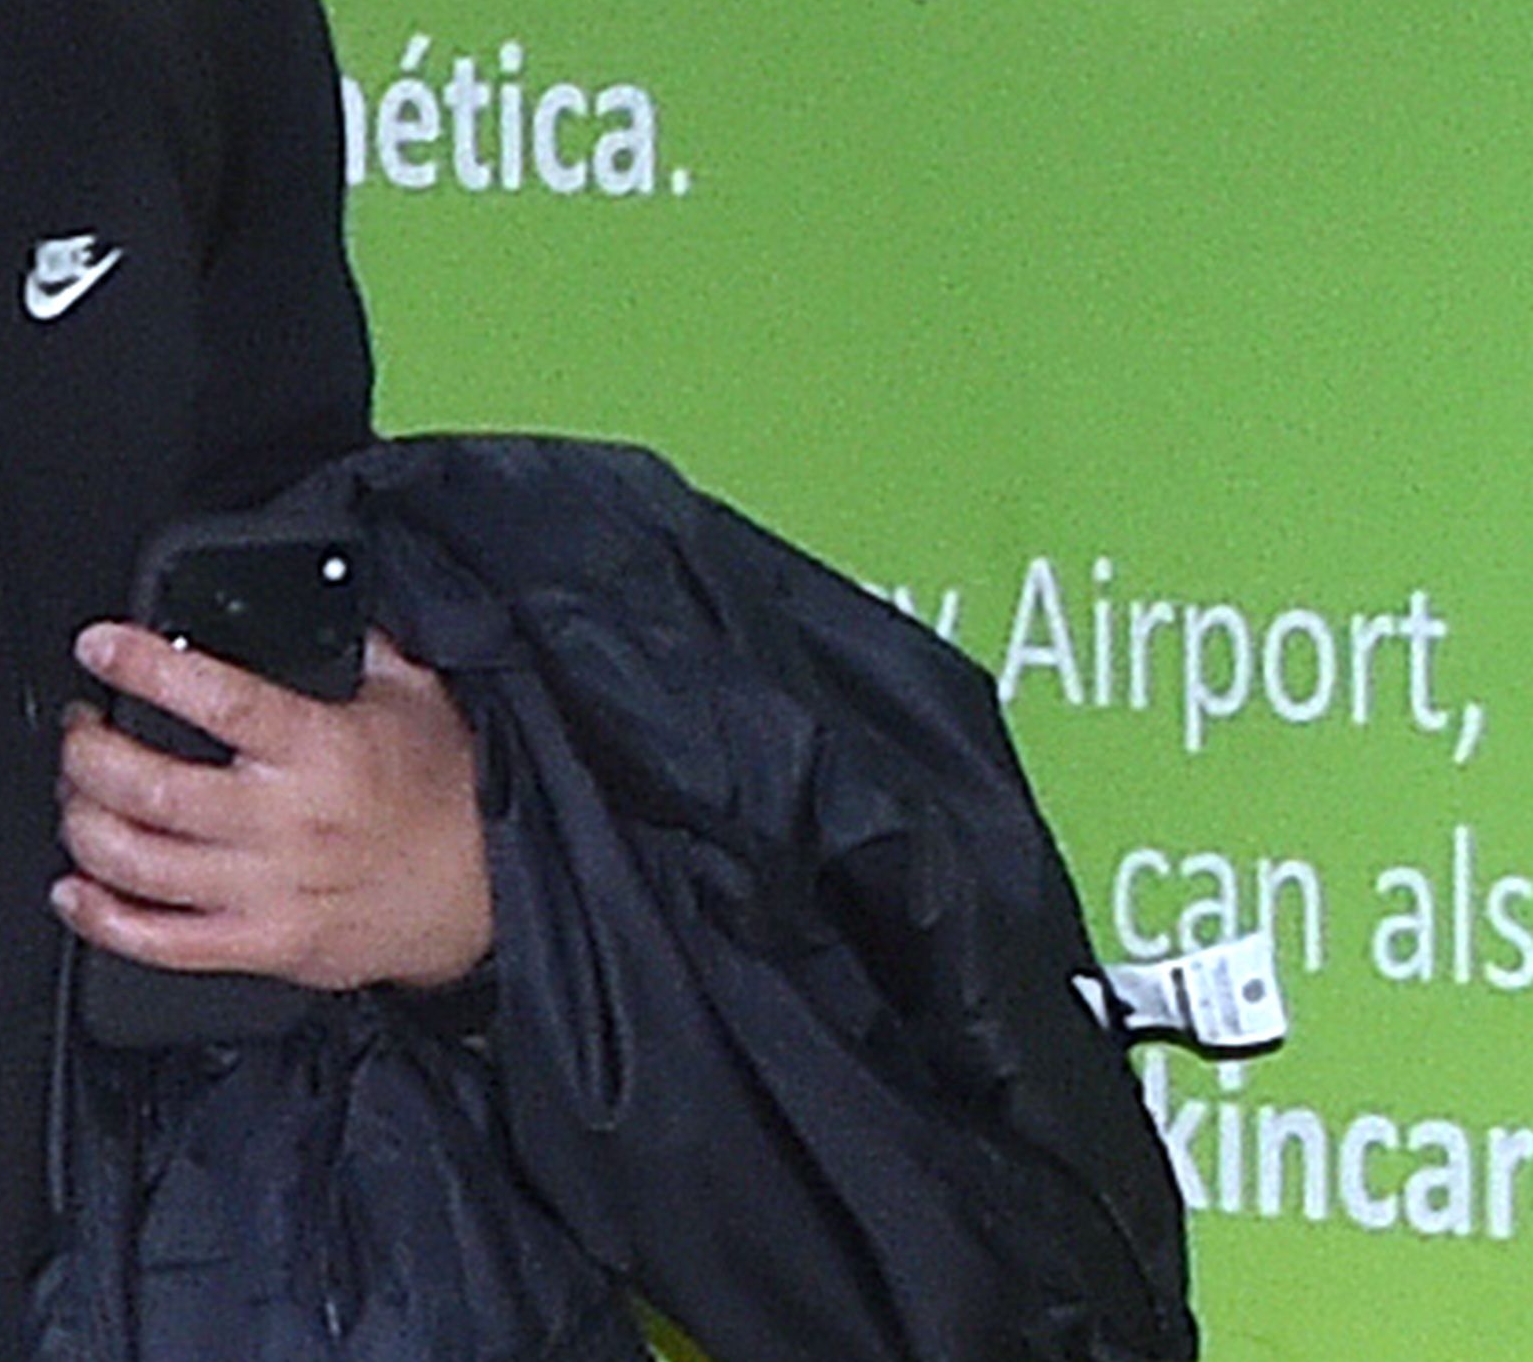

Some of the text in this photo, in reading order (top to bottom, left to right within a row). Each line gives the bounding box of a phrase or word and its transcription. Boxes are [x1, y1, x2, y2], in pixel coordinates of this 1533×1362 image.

[998, 556, 1484, 764] Airport,
[1112, 824, 1533, 990] can als
